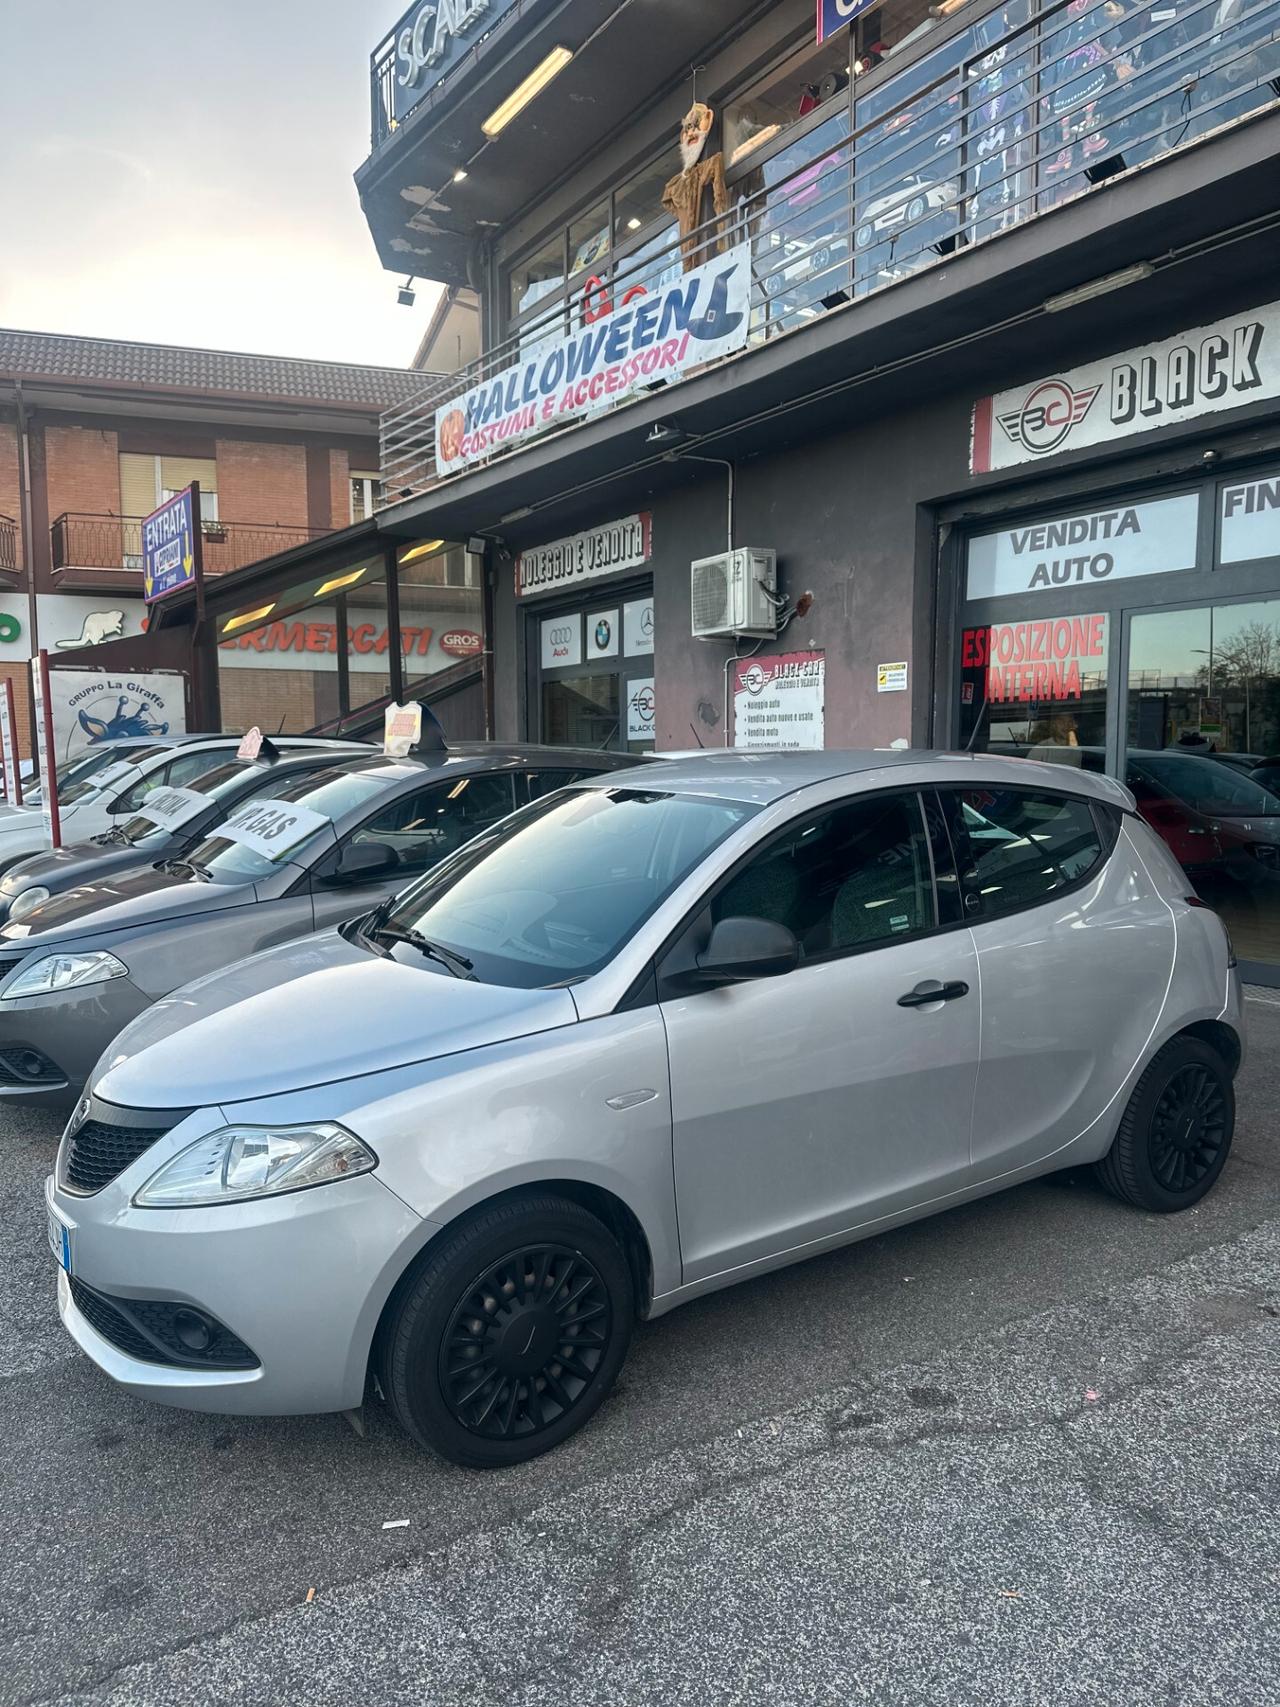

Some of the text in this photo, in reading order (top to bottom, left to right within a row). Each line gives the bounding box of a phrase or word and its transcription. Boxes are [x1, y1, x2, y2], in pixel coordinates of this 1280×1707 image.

[464, 278, 700, 434] HALLOWEEN
[1110, 322, 1265, 426] BLACK
[460, 334, 690, 458] COSTUMI E ACCESSORI
[146, 500, 187, 552] ENTRATA
[1009, 508, 1142, 555] VENDITA
[520, 520, 645, 588] NOLEGGIO E VENDITA
[1028, 552, 1115, 588] AUTO
[444, 634, 480, 646] GROS
[552, 647, 569, 658] Audi
[961, 614, 1106, 668] ESPOSIZIONE
[68, 681, 165, 709] GRUPPO La Giraffa
[984, 660, 1083, 704] INTERNA
[629, 724, 651, 732] BLACK
